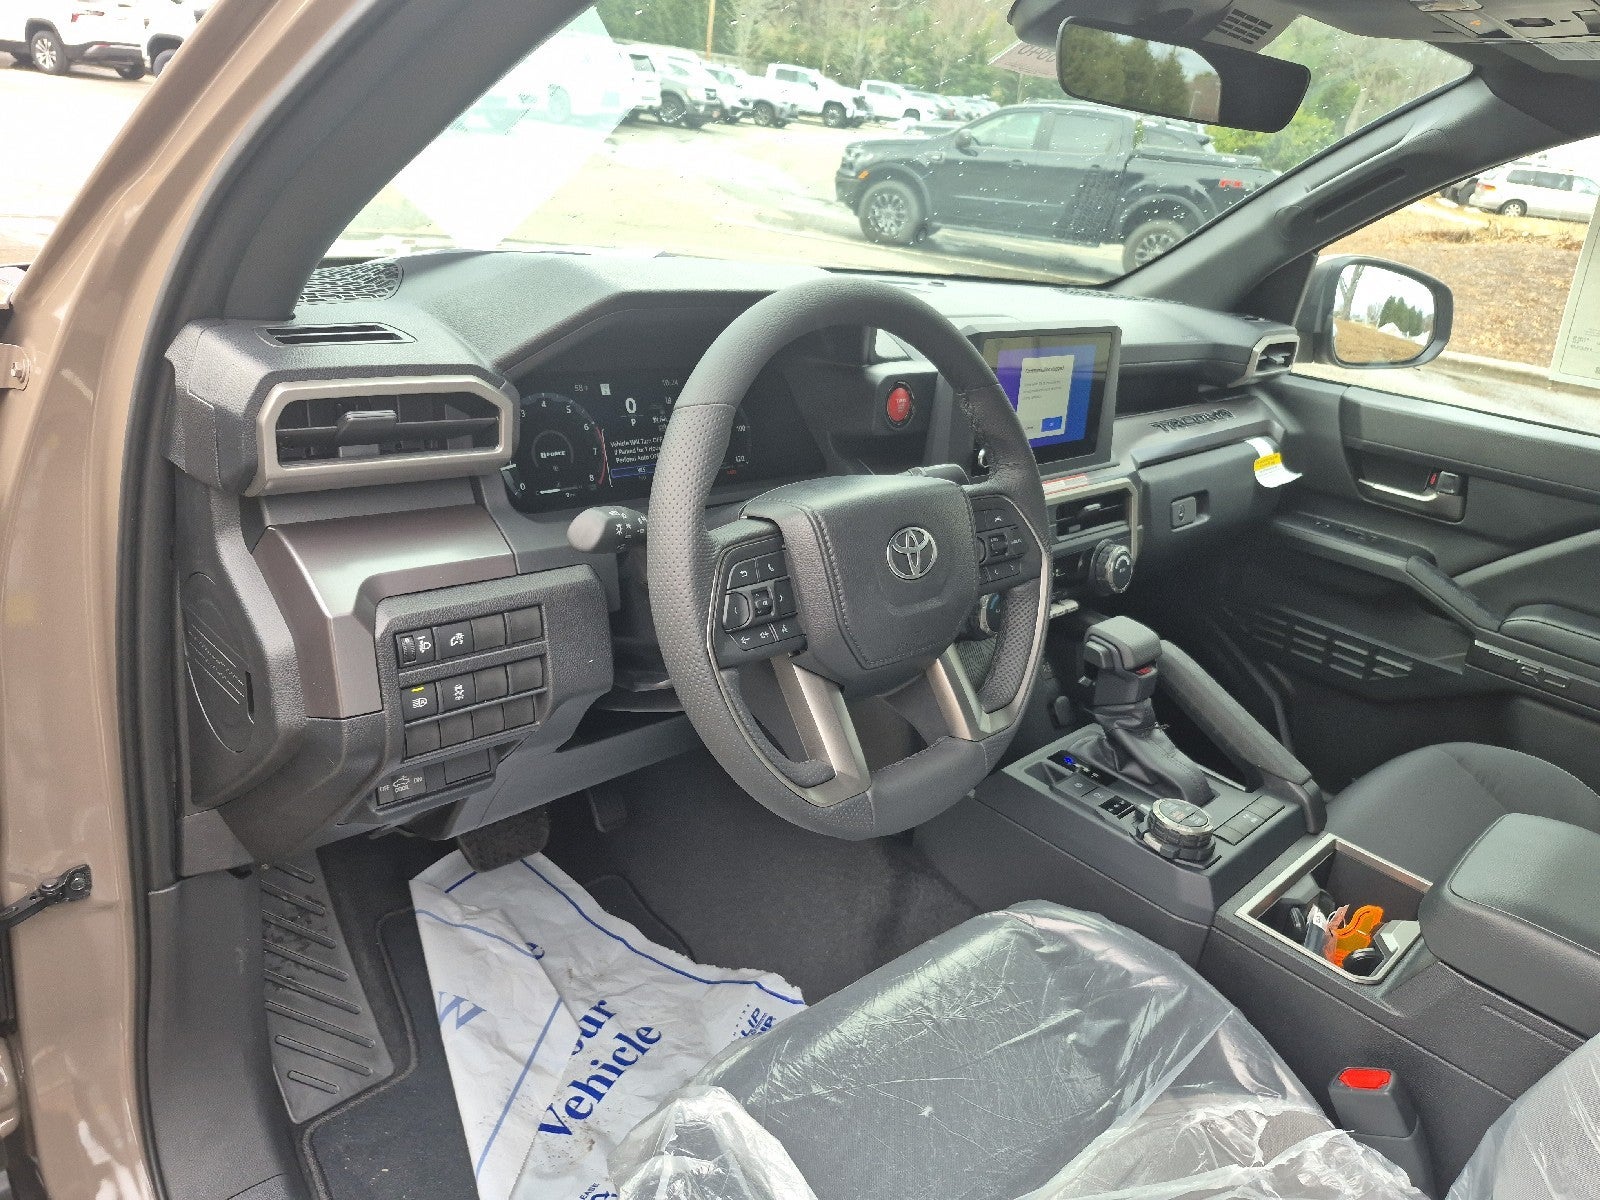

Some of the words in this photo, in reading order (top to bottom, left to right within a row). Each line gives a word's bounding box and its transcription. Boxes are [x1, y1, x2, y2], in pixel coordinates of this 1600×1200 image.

[541, 400, 547, 408] 4
[624, 397, 638, 414] 0
[520, 409, 526, 418] 3
[566, 405, 572, 414] 5
[583, 423, 590, 431] 6
[589, 474, 595, 482] 8
[520, 482, 526, 491] 0
[537, 1023, 663, 1137] Vehicle
